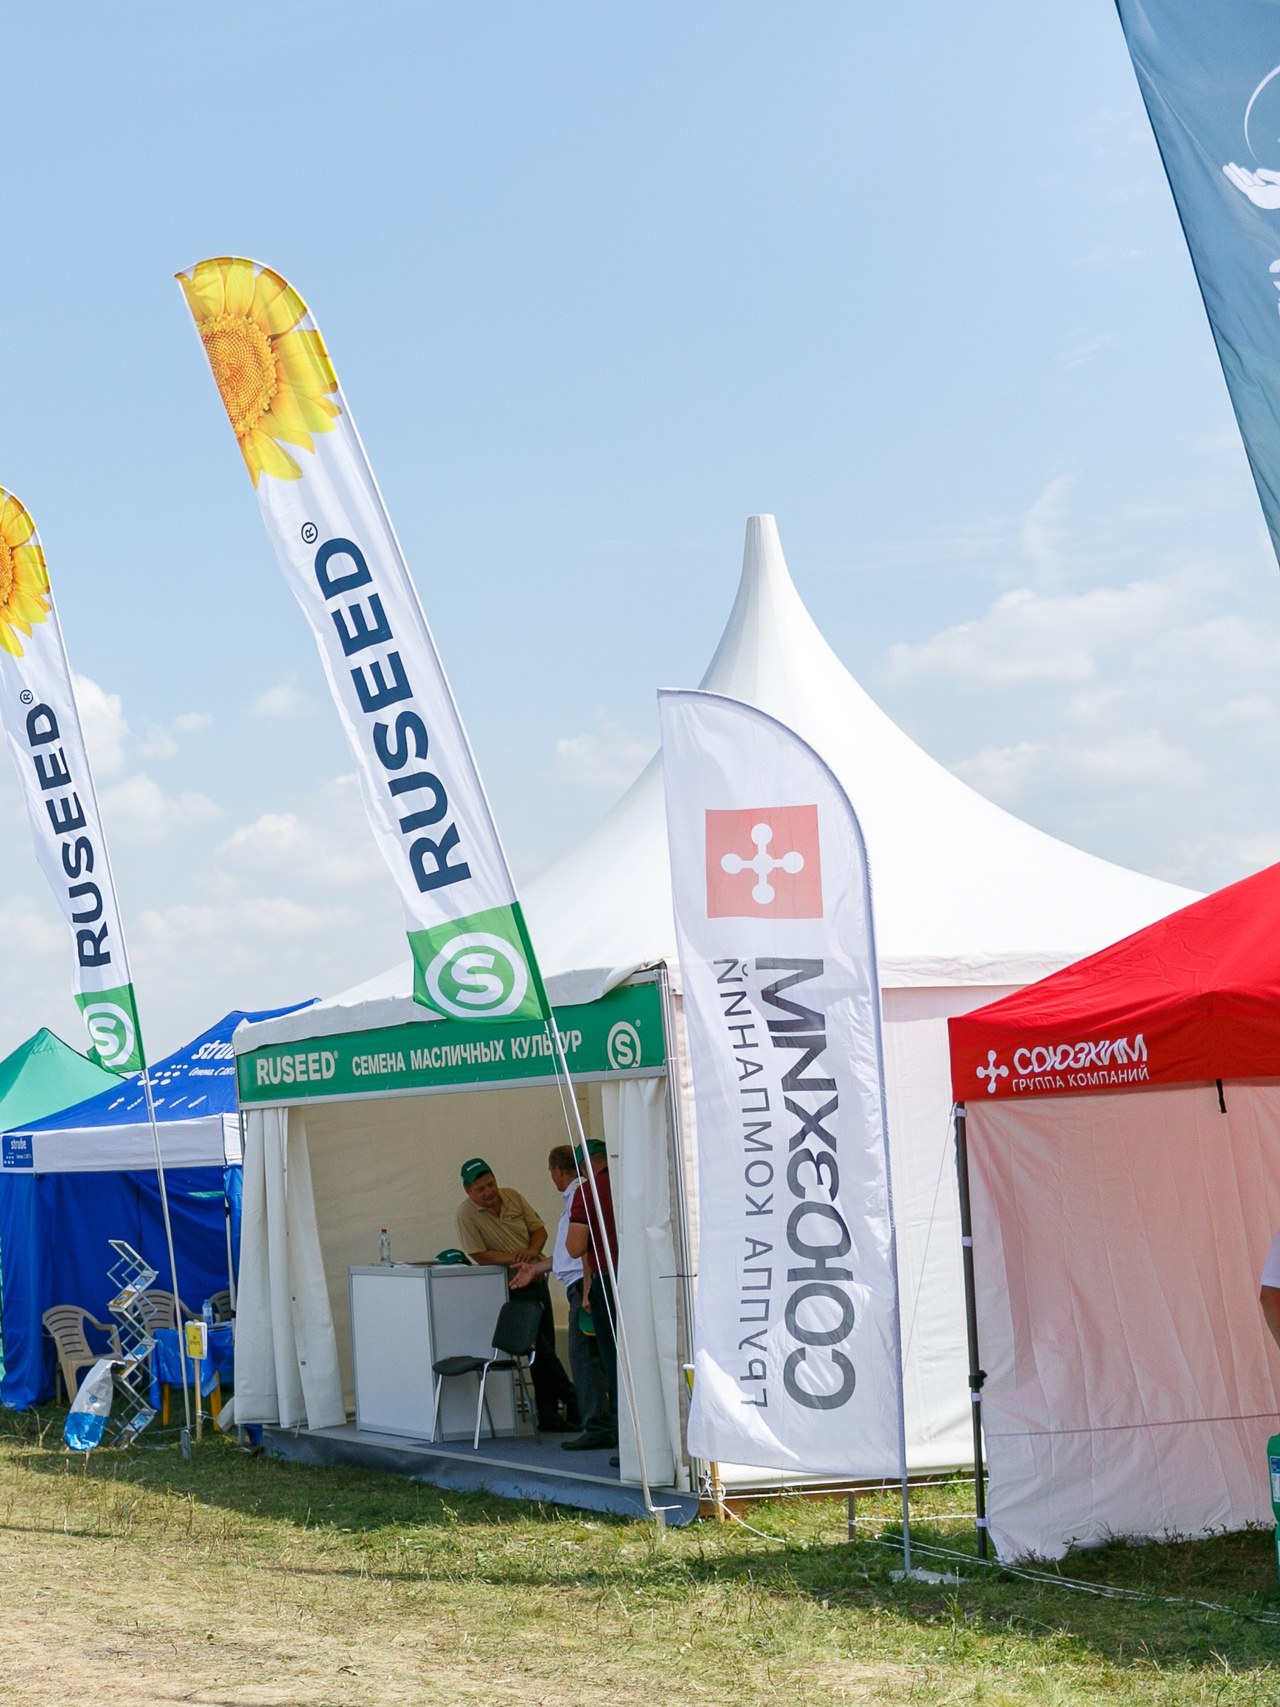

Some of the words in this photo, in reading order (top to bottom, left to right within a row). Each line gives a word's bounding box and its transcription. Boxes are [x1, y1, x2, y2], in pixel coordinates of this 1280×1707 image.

[351, 1051, 406, 1076] СЕМЕНА
[410, 1039, 505, 1070] МАСЛИЧНЫХ
[1012, 1033, 1148, 1076] СОЮЗХИМ
[1012, 1076, 1065, 1092] ГРУППА
[1069, 1064, 1150, 1087] КОМПАНИЙ
